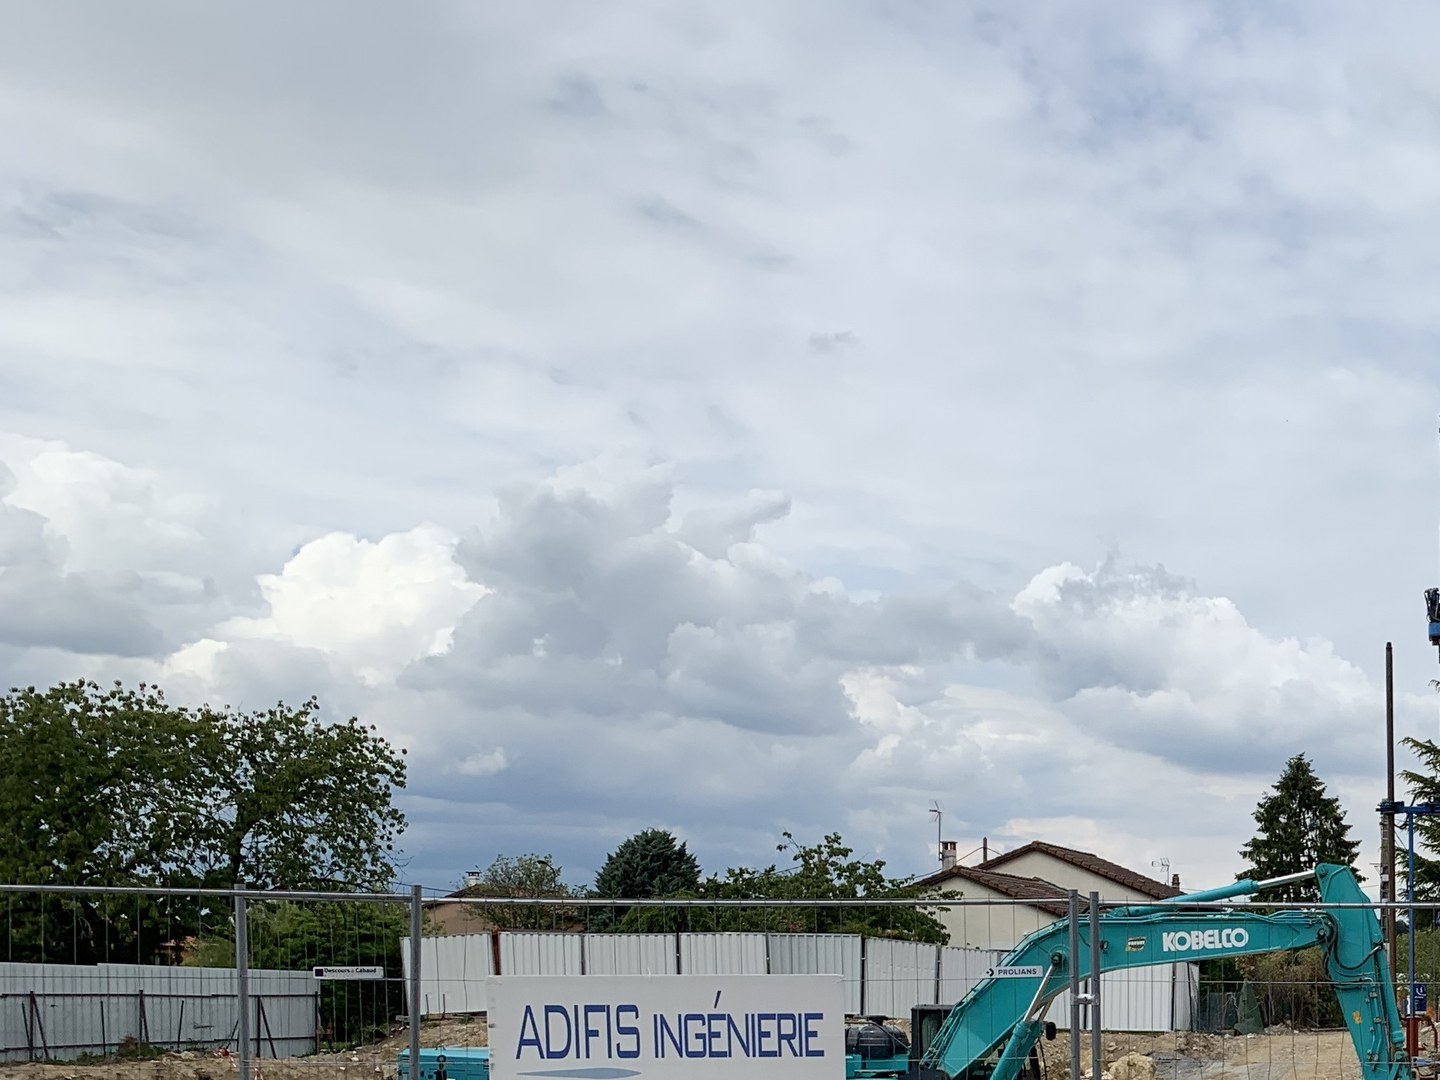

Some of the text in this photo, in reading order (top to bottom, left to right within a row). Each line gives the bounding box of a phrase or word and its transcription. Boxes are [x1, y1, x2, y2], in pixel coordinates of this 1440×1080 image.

[1162, 927, 1249, 952] KOBELCO
[997, 968, 1038, 976] PROLIANS
[516, 990, 825, 1060] ADIFIS INGÉNIERIE
